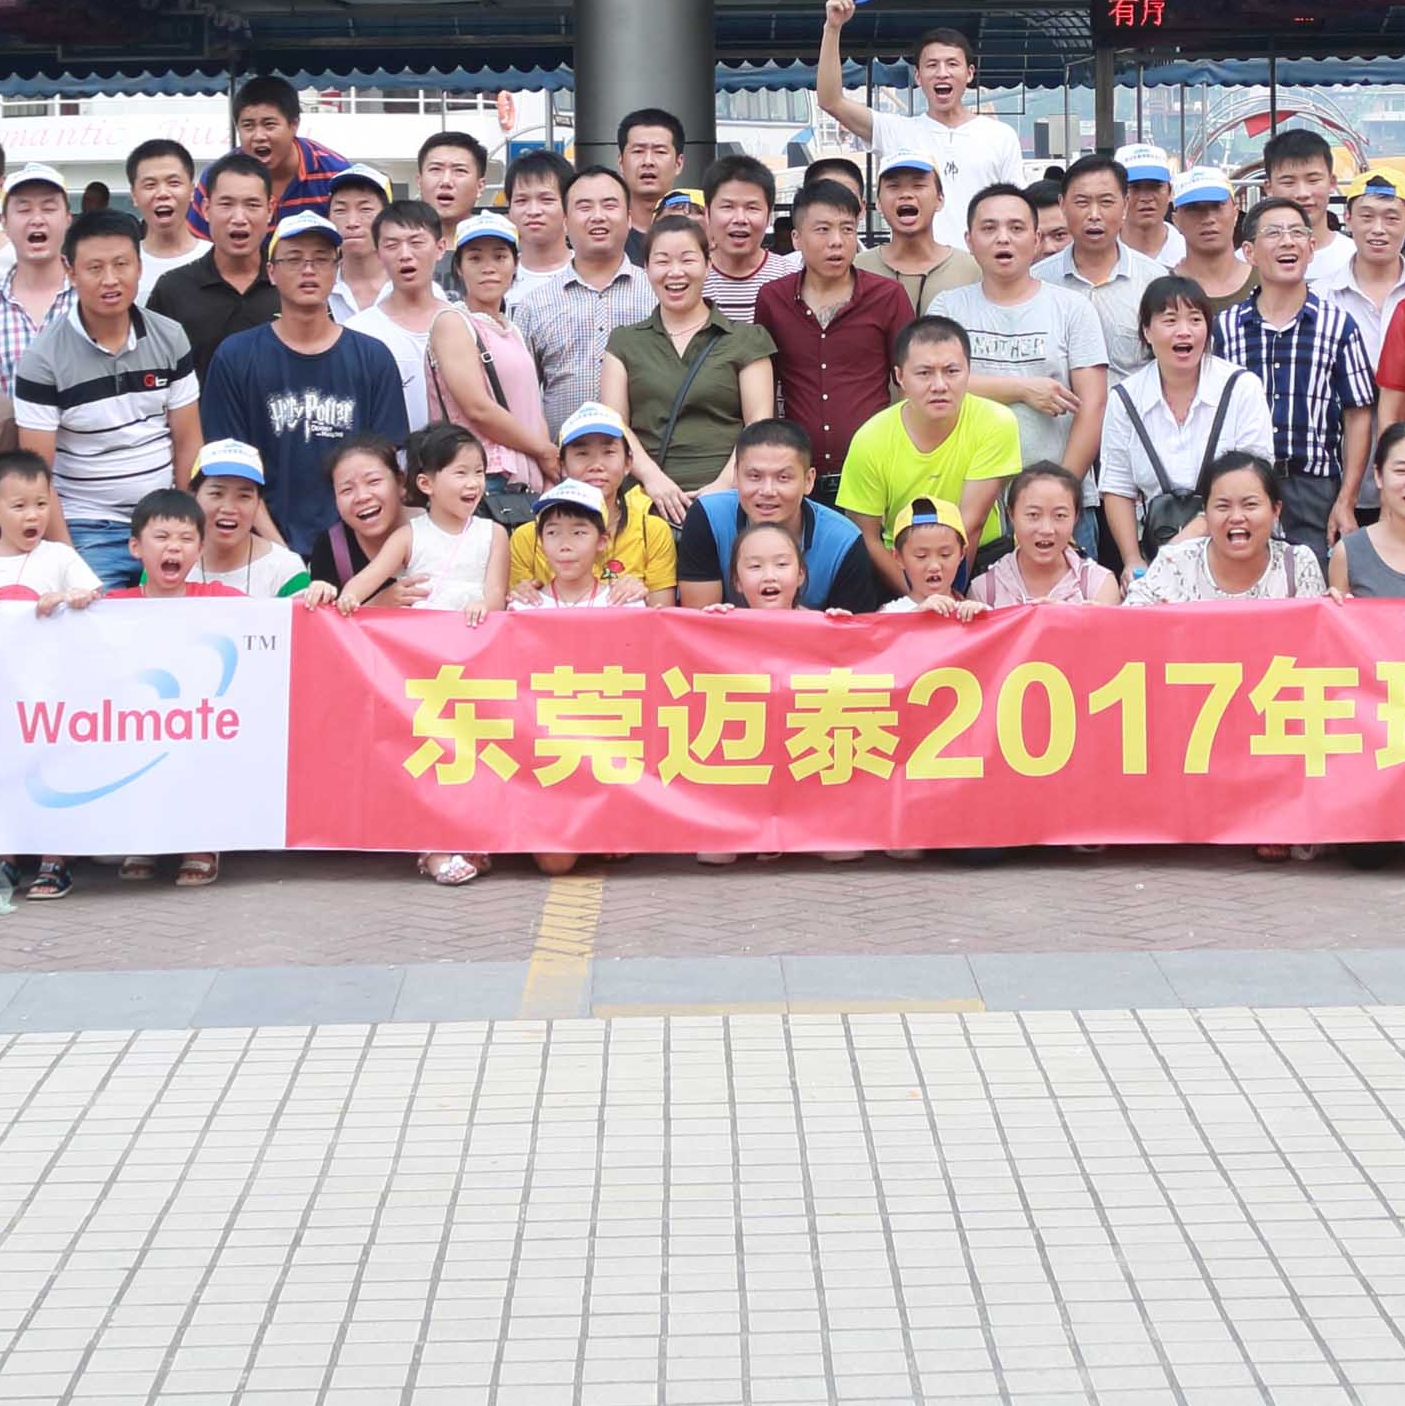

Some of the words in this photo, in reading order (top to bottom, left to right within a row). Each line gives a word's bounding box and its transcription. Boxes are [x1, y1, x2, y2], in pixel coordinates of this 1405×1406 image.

[943, 161, 959, 181] 佛
[972, 337, 1045, 358] NOTHER
[242, 633, 277, 652] TM
[17, 698, 240, 748] Walmate
